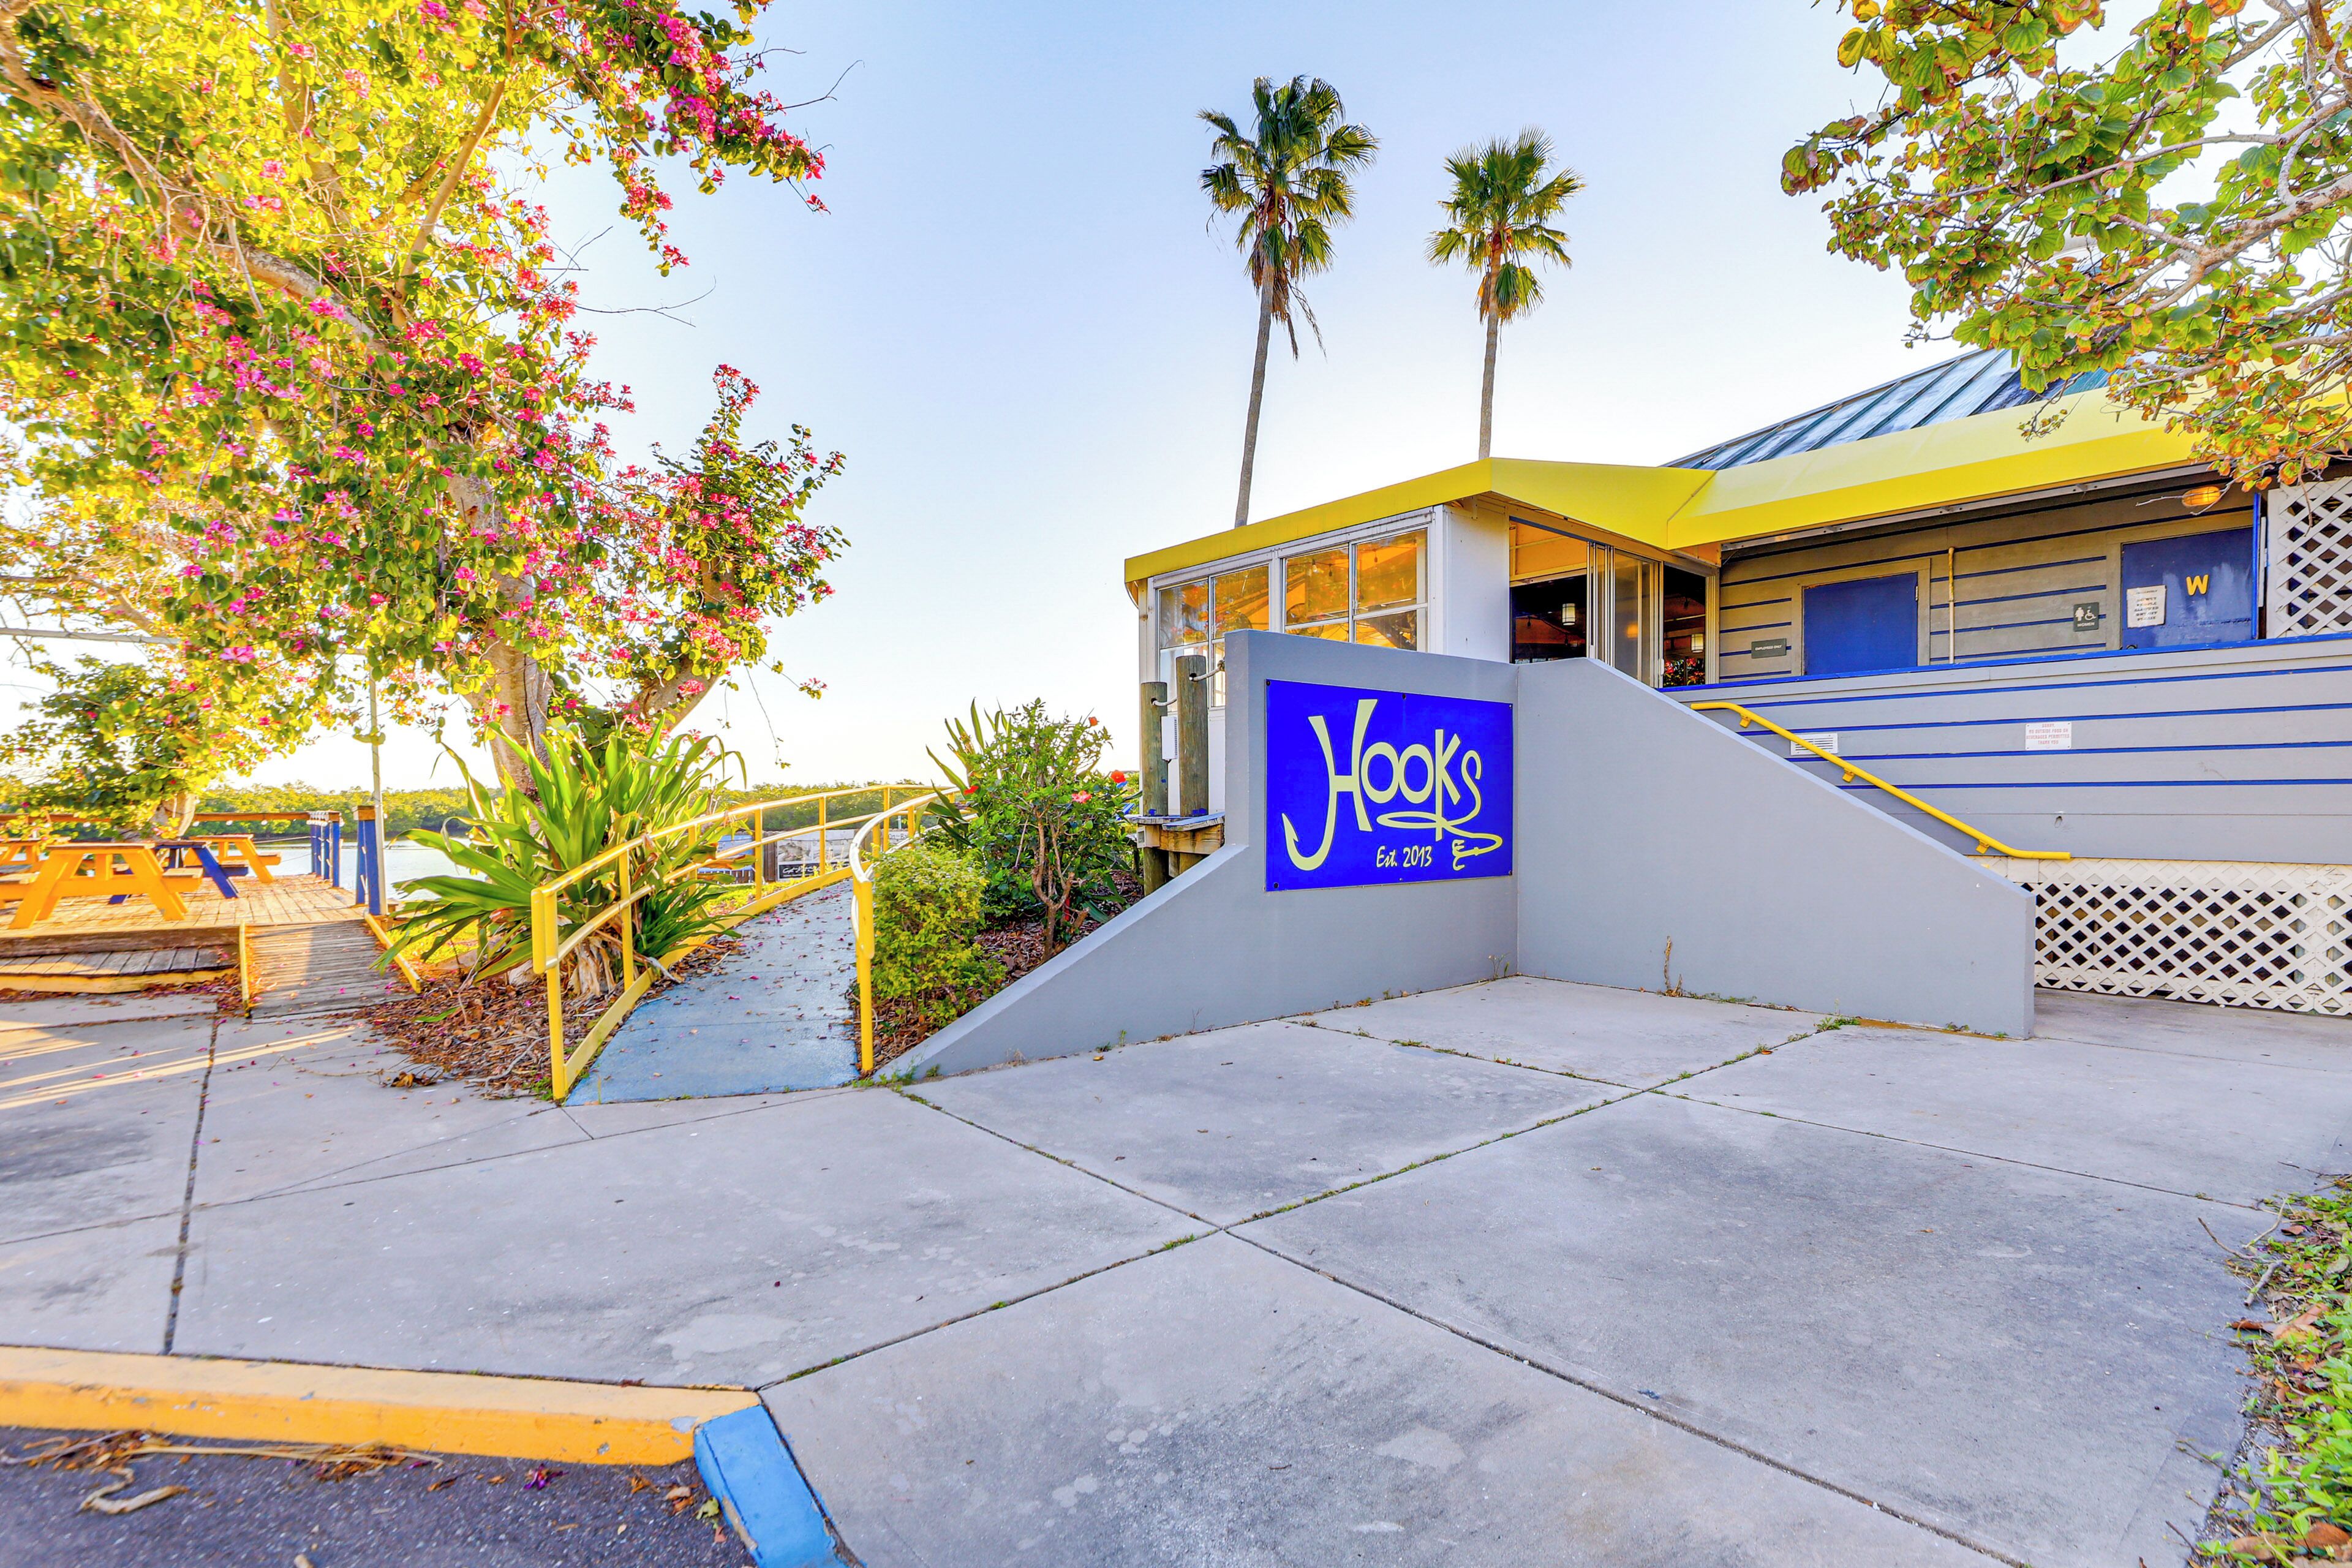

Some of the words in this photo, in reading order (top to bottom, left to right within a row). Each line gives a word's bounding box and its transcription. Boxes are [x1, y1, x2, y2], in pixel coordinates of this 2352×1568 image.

[2186, 574, 2209, 596] W
[1376, 845, 1398, 868] Est.
[1403, 845, 1433, 868] 2013
